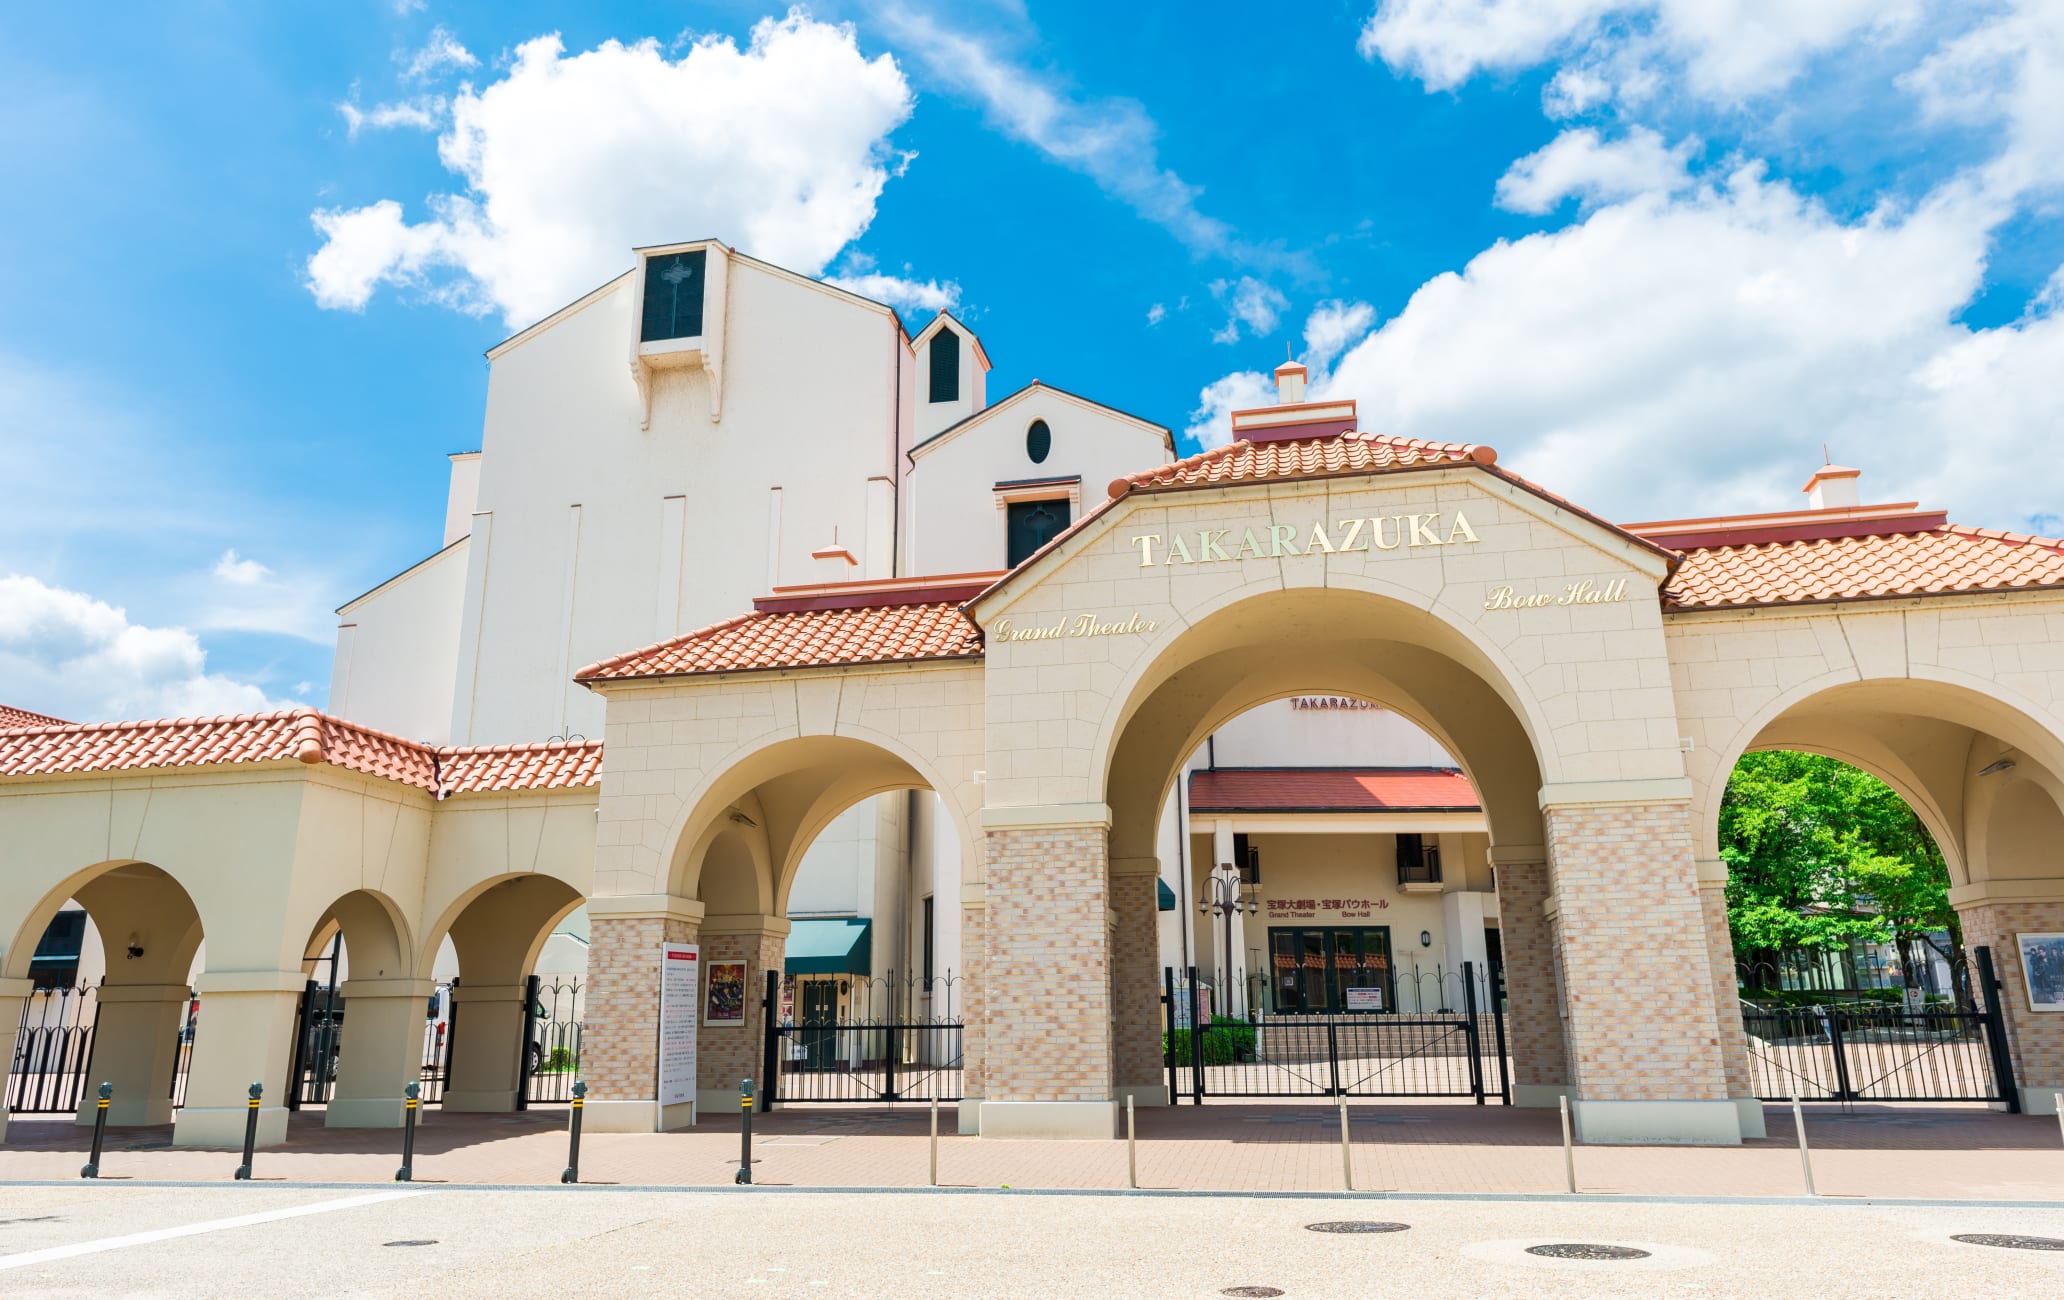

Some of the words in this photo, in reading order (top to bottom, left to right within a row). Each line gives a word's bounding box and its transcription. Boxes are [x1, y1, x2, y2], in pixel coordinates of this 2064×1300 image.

[1131, 510, 1481, 567] TAKARAZUKA
[1484, 585, 1554, 610] Bow
[1557, 578, 1628, 606] Hall
[993, 616, 1067, 642] Grand
[1070, 612, 1159, 638] Theater
[1290, 697, 1383, 710] TAKARAZU
